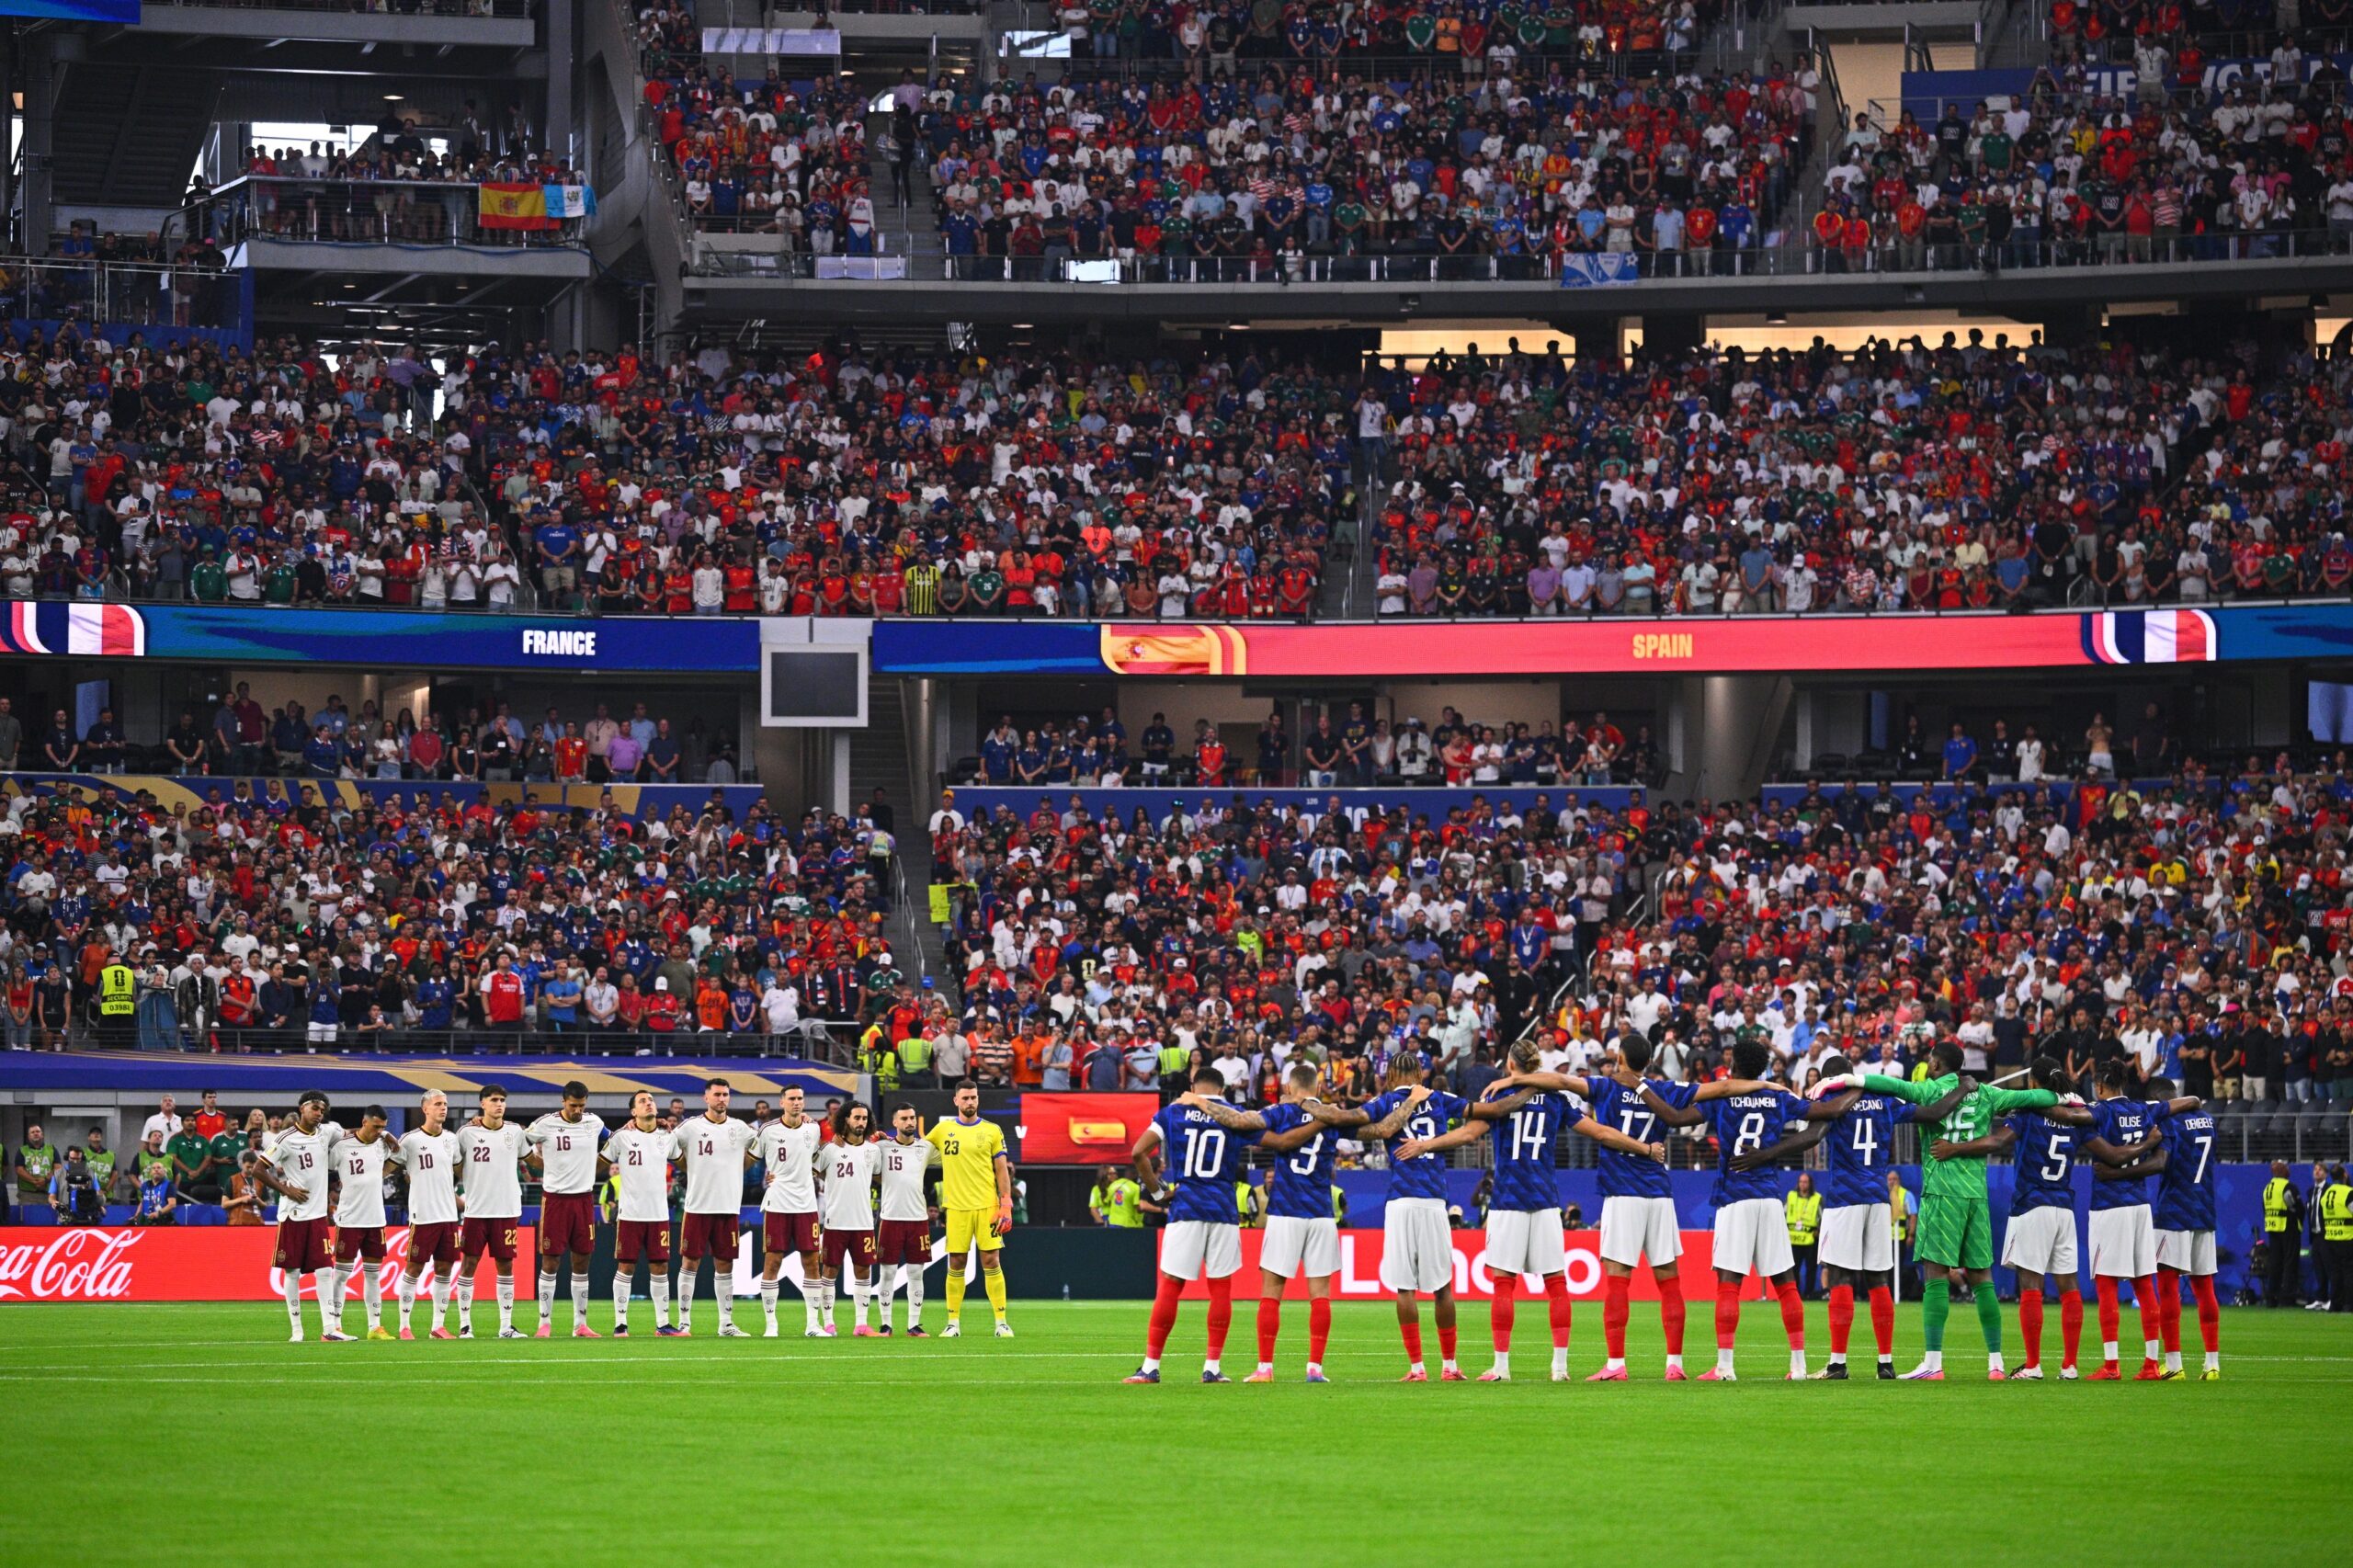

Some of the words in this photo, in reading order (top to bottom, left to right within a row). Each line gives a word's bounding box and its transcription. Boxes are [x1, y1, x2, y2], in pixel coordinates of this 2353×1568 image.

[522, 630, 596, 655] FRANCE
[1632, 633, 1693, 659] SPAIN
[497, 880, 508, 889] 20
[2119, 1115, 2143, 1128] OLISE
[1509, 1111, 1547, 1161] 14
[1619, 1109, 1655, 1157] 17
[1733, 1112, 1766, 1156] 8
[556, 1136, 571, 1152] 16
[698, 1140, 713, 1156] 14
[944, 1140, 959, 1155] 23
[1852, 1118, 1878, 1166] 4
[298, 1152, 313, 1170] 19
[418, 1153, 434, 1170] 10
[472, 1146, 490, 1163] 22
[628, 1150, 642, 1165] 21
[779, 1147, 787, 1162] 8
[1183, 1128, 1226, 1178] 10
[1290, 1132, 1324, 1176] 3
[2040, 1134, 2071, 1182] 5
[2193, 1136, 2212, 1184] 7
[349, 1159, 365, 1175] 12
[836, 1162, 854, 1178] 24
[888, 1155, 903, 1171] 15
[505, 1229, 517, 1245] 22
[812, 1221, 819, 1239] 8
[920, 1233, 931, 1251] 15
